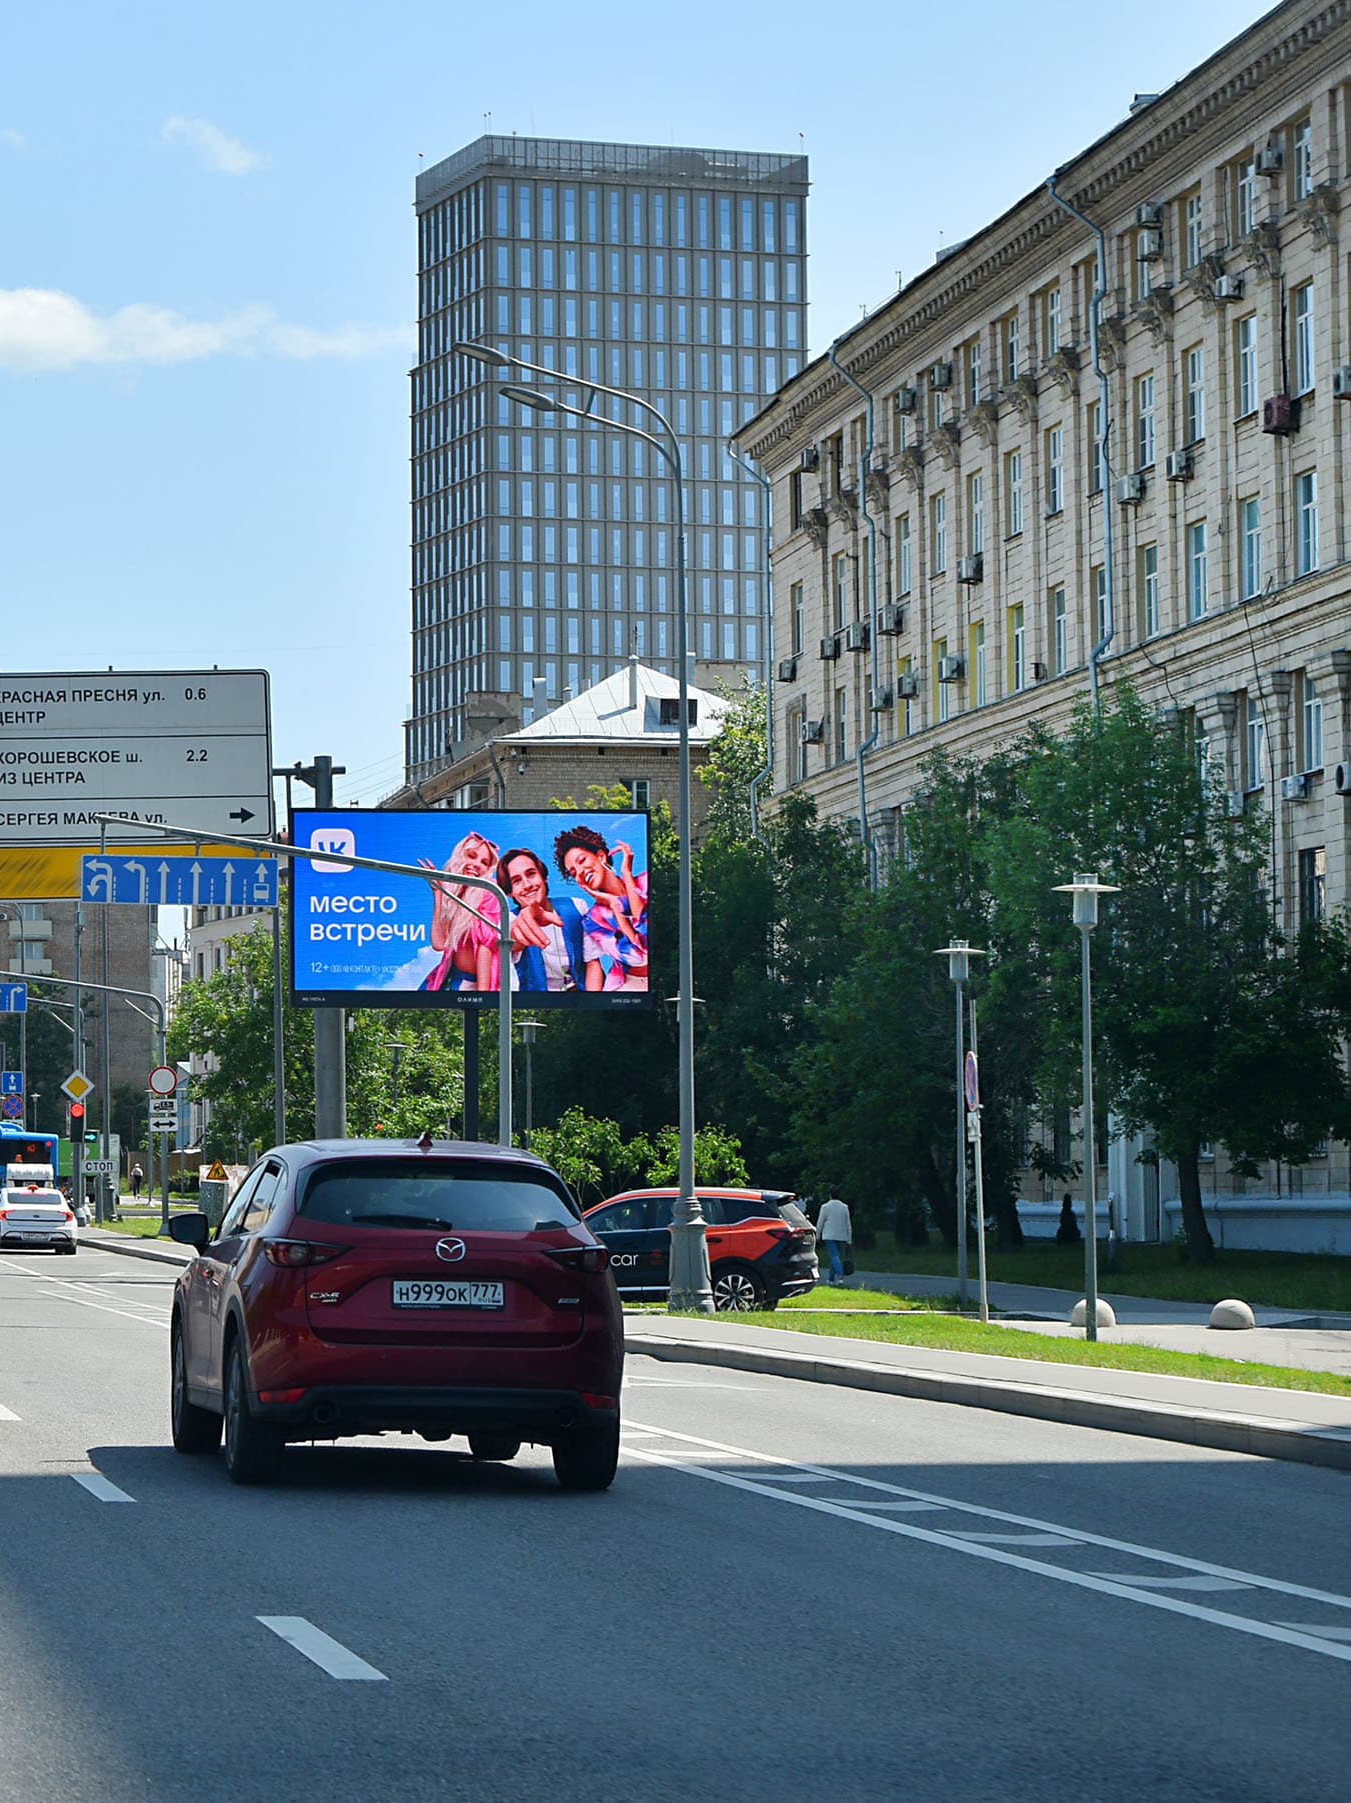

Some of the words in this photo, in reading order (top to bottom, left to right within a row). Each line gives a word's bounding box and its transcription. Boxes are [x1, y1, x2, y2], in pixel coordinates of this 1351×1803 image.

[72, 689, 138, 702] ПРЕСНЯ
[142, 691, 166, 704] ул.
[184, 688, 207, 700] 0.6
[125, 753, 143, 763] ш.
[186, 749, 208, 762] 2.2
[21, 771, 86, 786] ЦЕНТРА
[63, 811, 140, 825] МАКВА
[310, 895, 397, 913] место
[310, 922, 426, 946] встречи
[311, 961, 330, 973] 12+
[85, 1162, 114, 1172] СТОП
[610, 1254, 639, 1267] car
